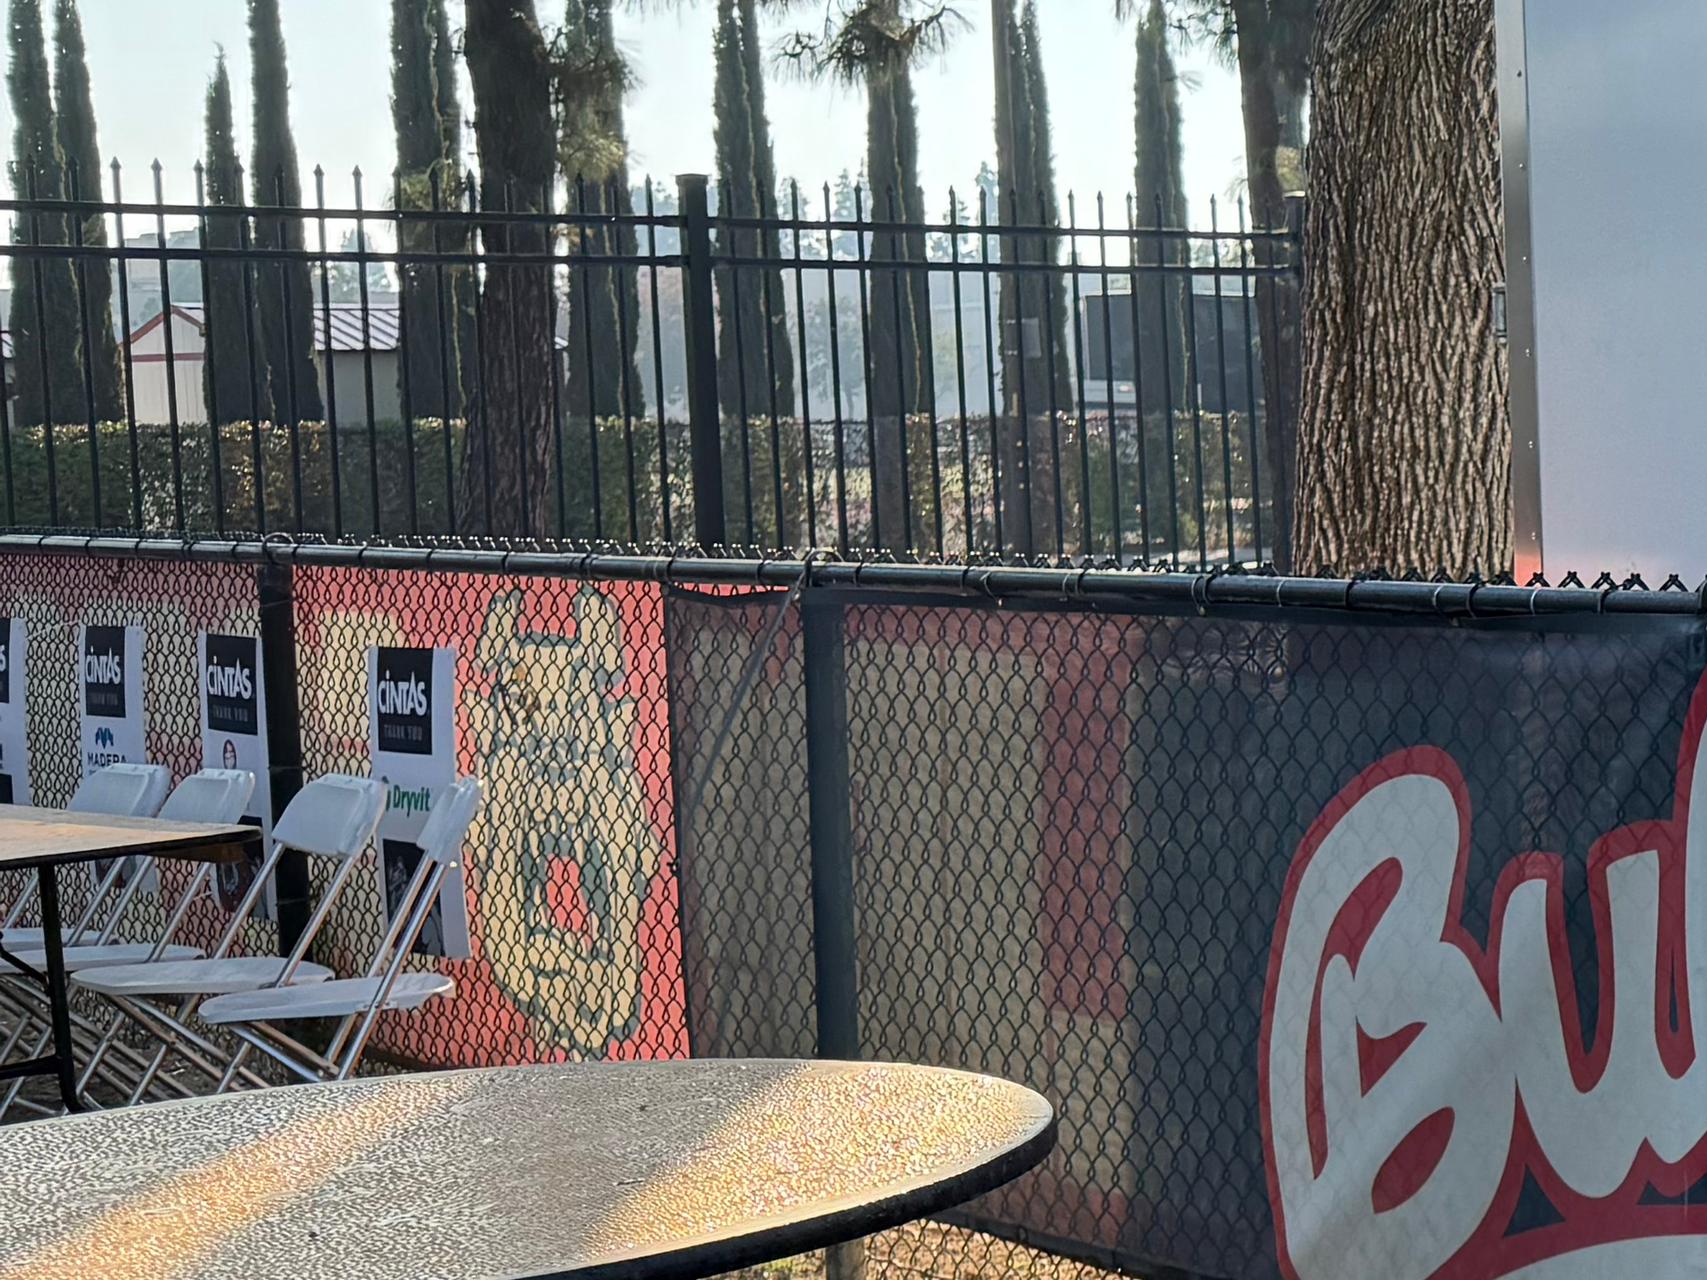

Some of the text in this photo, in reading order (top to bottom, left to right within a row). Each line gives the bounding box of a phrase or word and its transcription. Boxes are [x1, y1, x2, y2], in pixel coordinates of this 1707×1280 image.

[384, 723, 423, 742] THANK YOU
[392, 784, 431, 817] Dryvit
